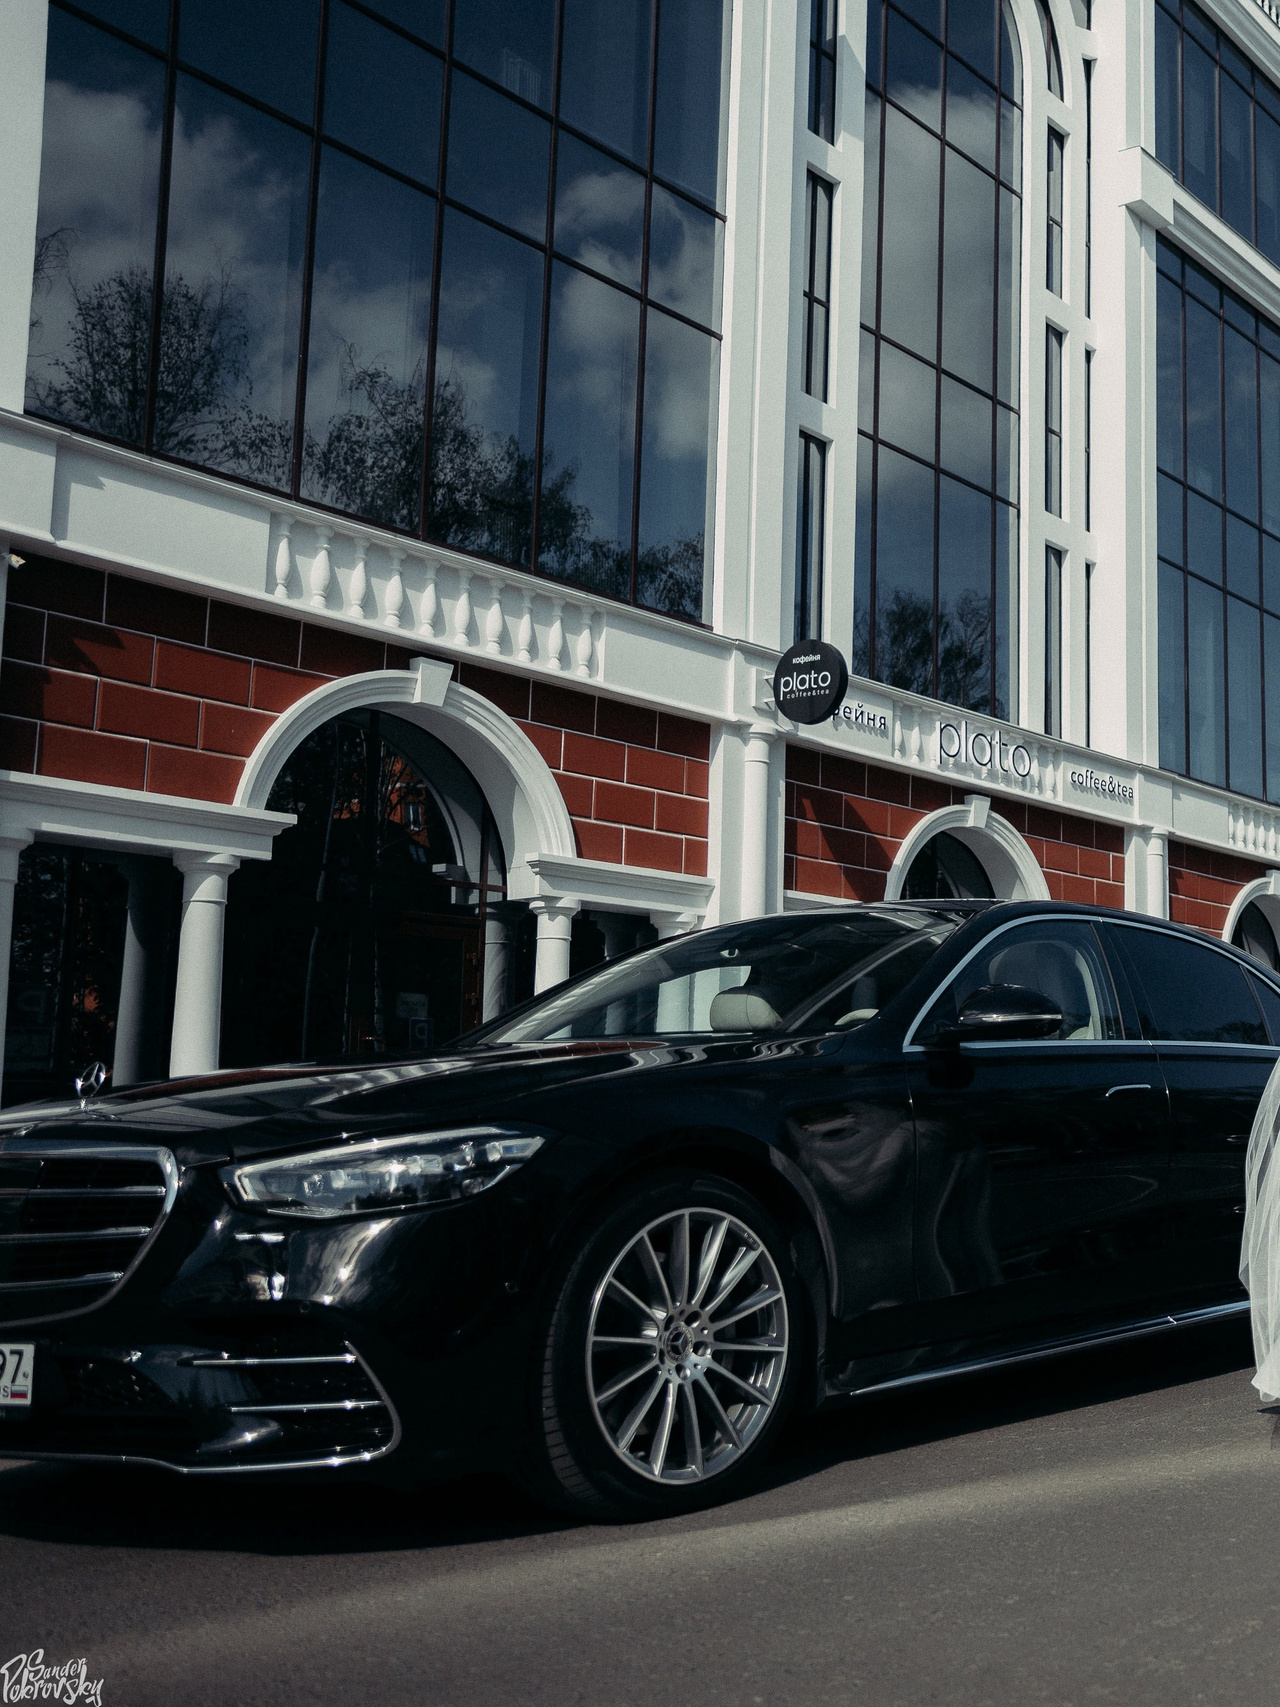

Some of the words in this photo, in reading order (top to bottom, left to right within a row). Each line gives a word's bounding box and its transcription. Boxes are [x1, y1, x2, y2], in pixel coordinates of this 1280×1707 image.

[792, 654, 821, 664] кофейня
[780, 670, 831, 701] plato
[786, 688, 829, 699] coffee&tea
[833, 703, 886, 730] ейня
[937, 720, 1031, 777] plato
[1070, 769, 1134, 799] coffee&tea
